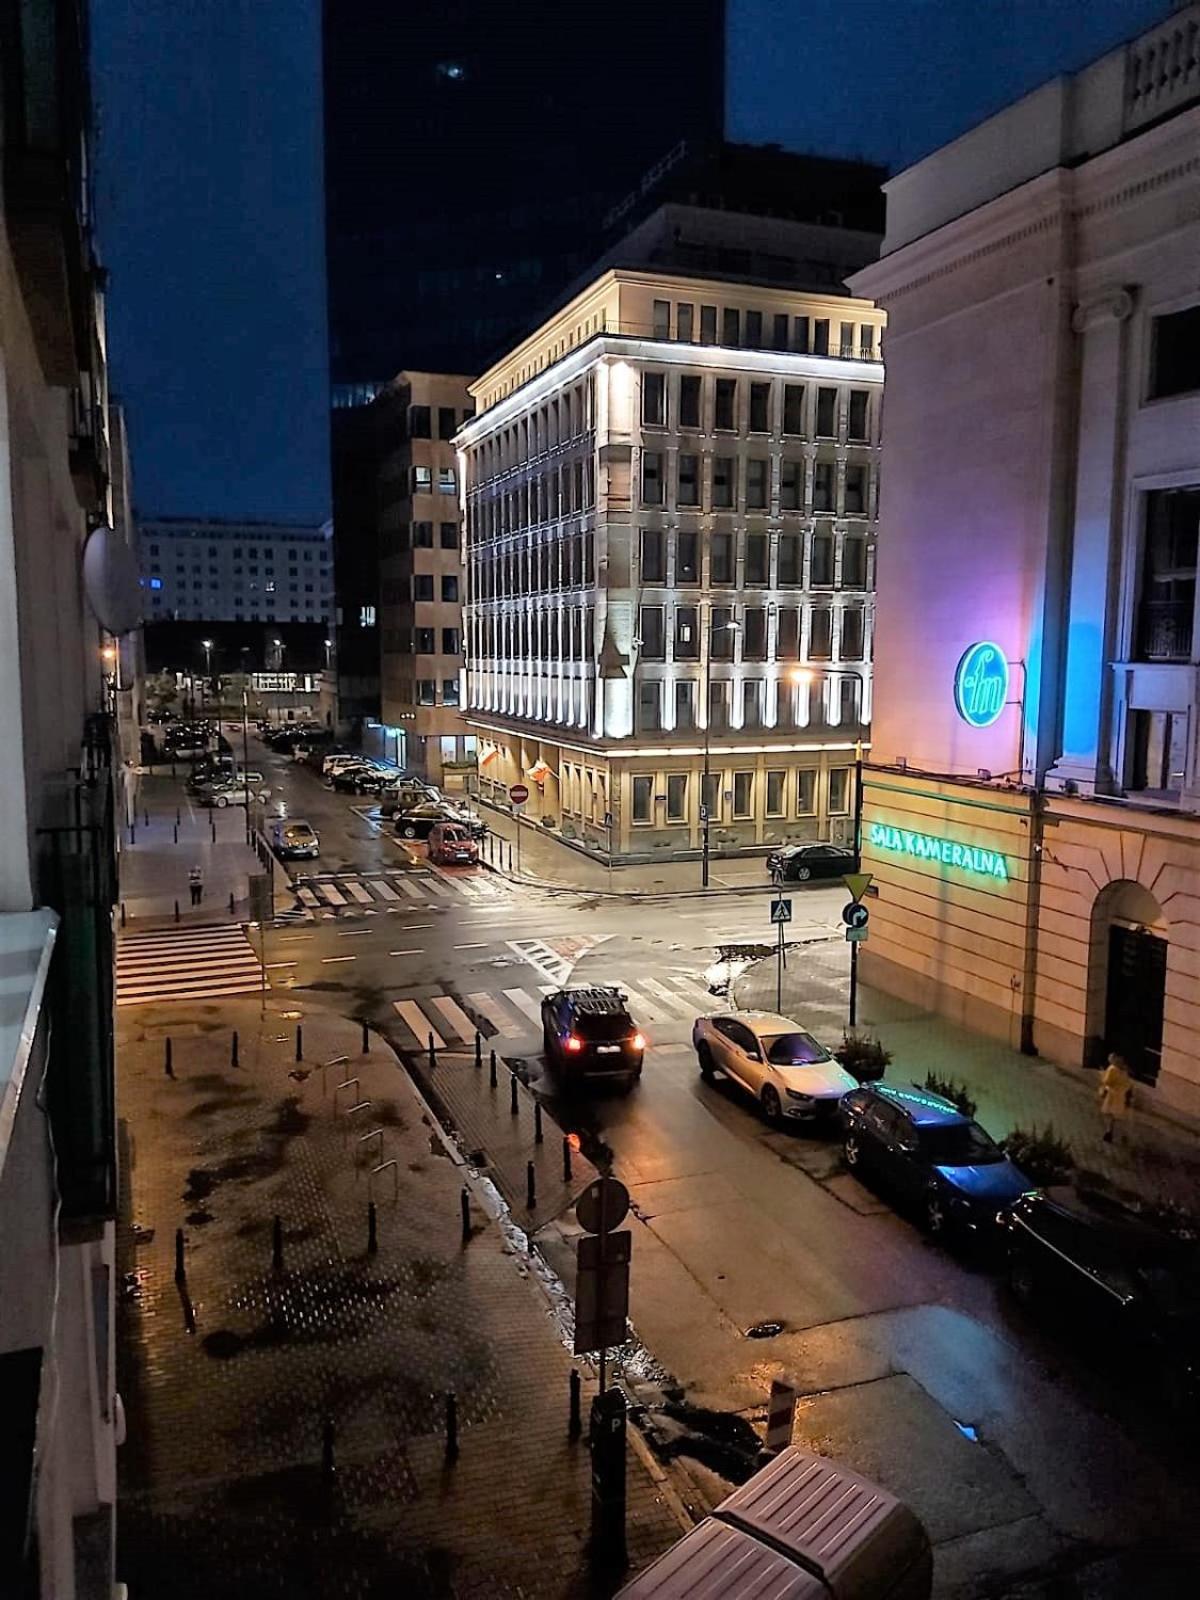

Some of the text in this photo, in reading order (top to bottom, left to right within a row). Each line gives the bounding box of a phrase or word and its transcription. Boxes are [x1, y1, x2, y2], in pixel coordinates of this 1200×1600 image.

[871, 824, 1008, 878] SALA KAMERALNA
[611, 1417, 622, 1433] P
